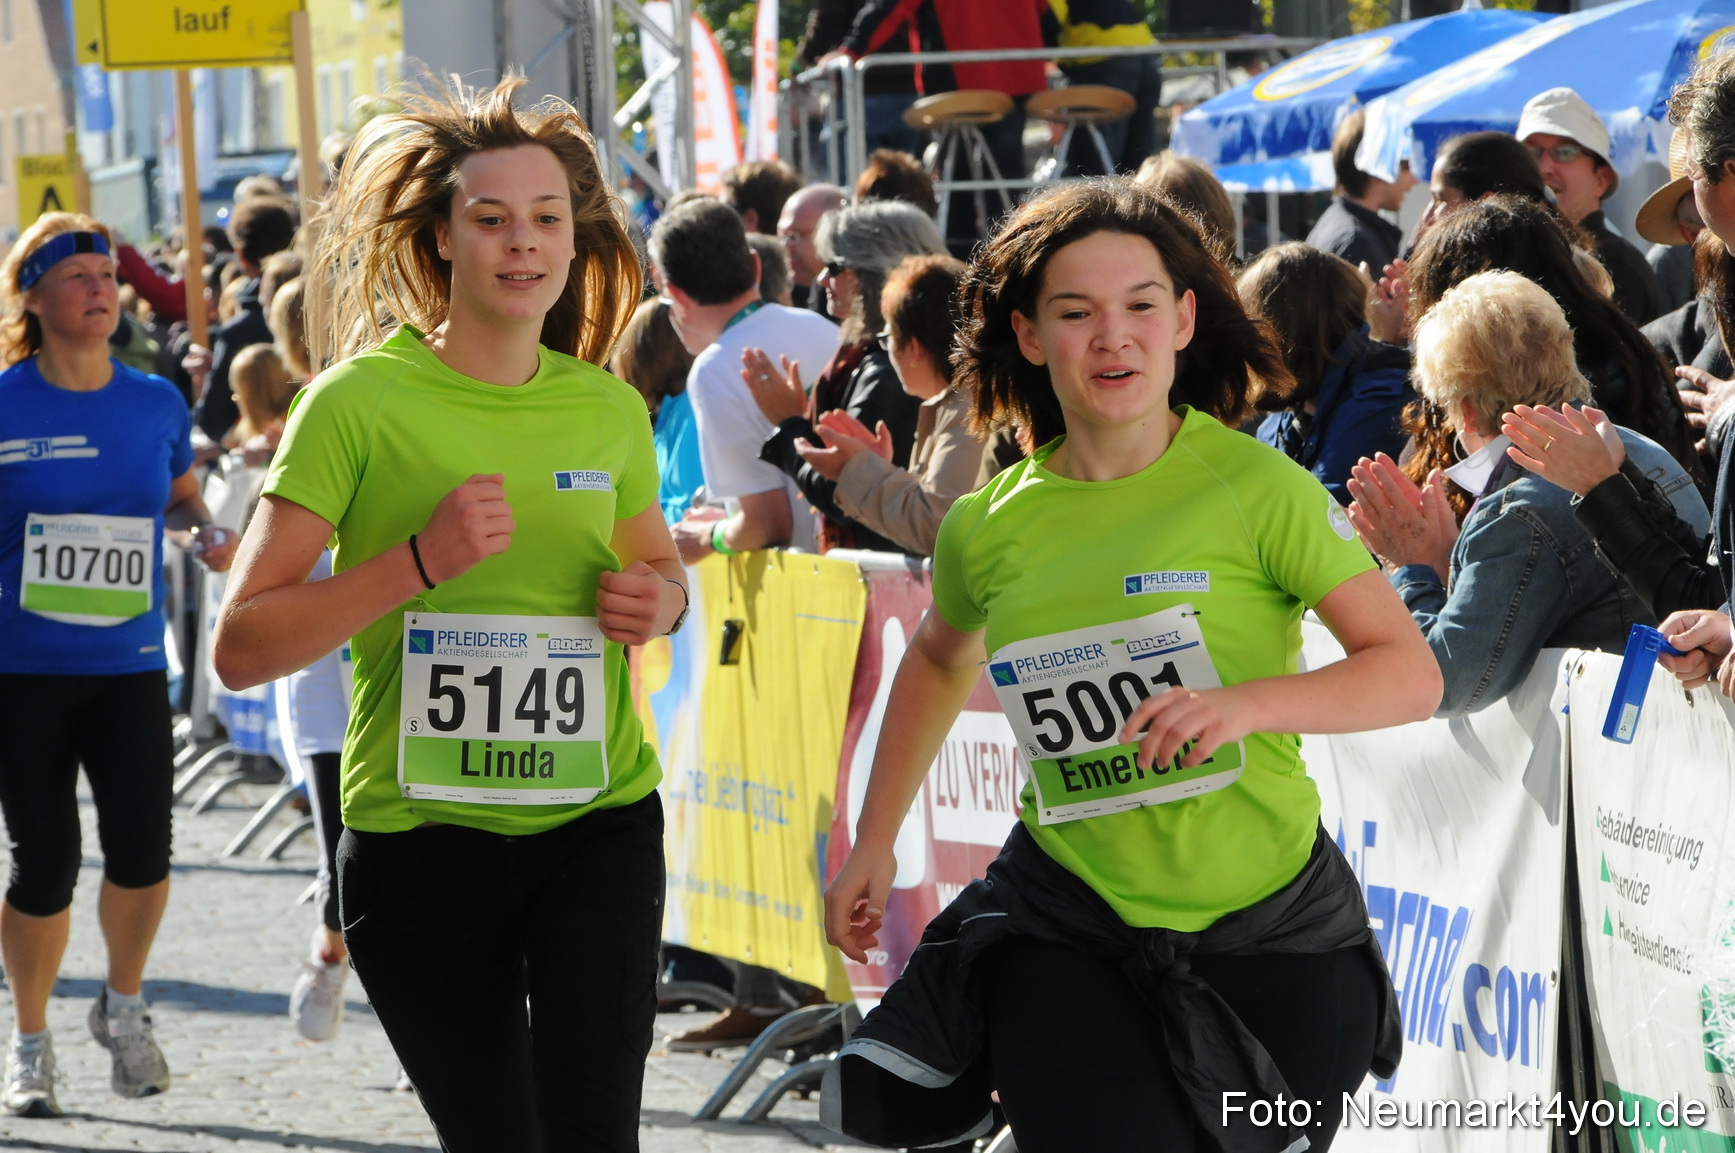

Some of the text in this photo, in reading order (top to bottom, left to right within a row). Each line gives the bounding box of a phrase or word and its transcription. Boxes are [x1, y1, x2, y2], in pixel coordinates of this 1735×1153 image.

[174, 6, 231, 32] lauf
[36, 184, 66, 218] A
[33, 544, 144, 586] 10700
[1144, 572, 1208, 585] PFLEIDERER
[1144, 584, 1208, 592] AKTIENGESELLSCHAFT
[437, 630, 528, 648] PFLEIDERER
[548, 638, 593, 650] BOCK
[1126, 630, 1182, 654] BOCK
[437, 648, 528, 659] AKTIENGESELLSCHAFT
[1015, 643, 1107, 675] PFLEIDERER
[1021, 659, 1110, 684] AKTIENGESELLSCHAFT
[427, 663, 585, 736] 5149
[461, 741, 555, 779] Linda
[937, 740, 960, 810] ZU
